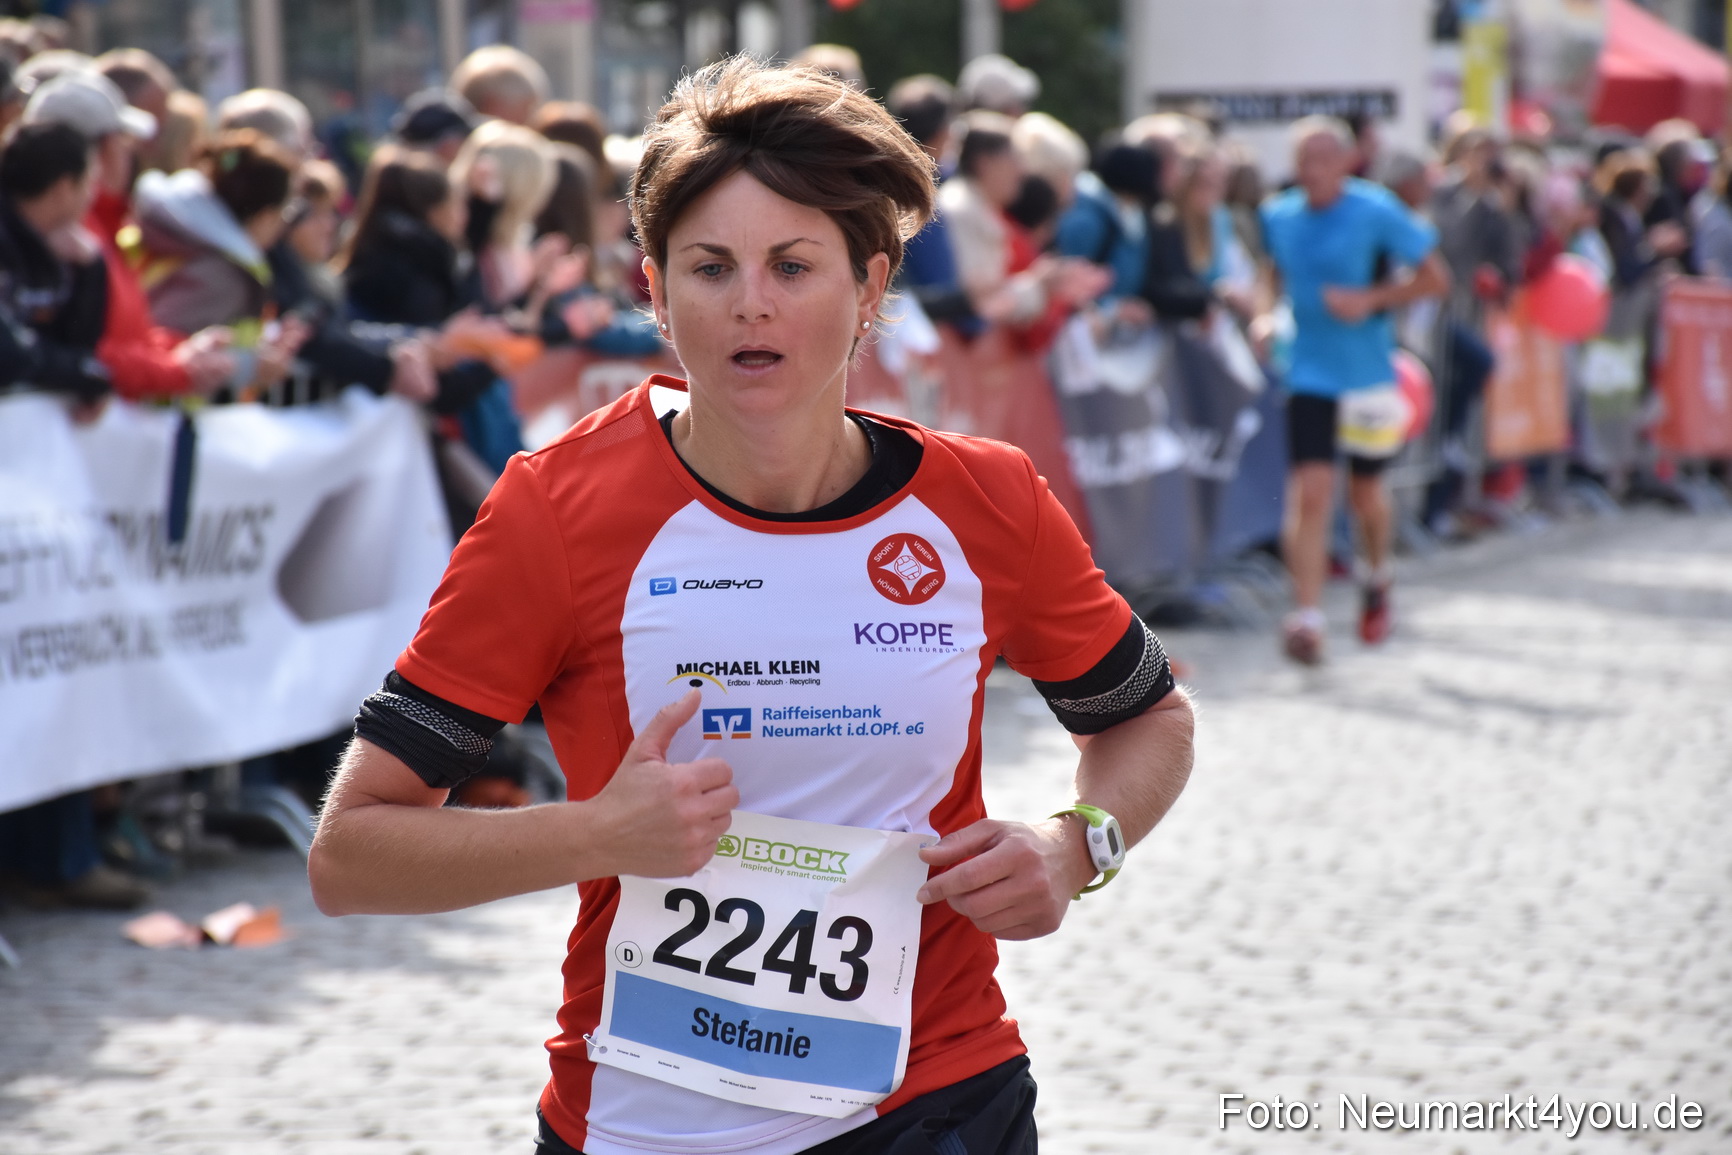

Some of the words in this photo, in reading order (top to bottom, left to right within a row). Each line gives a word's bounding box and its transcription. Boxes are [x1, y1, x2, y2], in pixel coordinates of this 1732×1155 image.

[873, 541, 895, 562] SPORT-
[913, 540, 934, 562] VEREIN
[921, 578, 939, 595] BERG
[853, 622, 954, 646] KOPPE
[676, 661, 763, 676] MICHAEL
[768, 660, 821, 675] KLEIN
[727, 679, 751, 687] Erdbau
[756, 678, 783, 686] Abbruch
[789, 678, 821, 687] Recycling
[761, 704, 882, 721] Raiffeisenbank
[761, 722, 843, 738] Neumarkt
[846, 722, 901, 737] i.d.OPf.
[905, 722, 925, 735] eG
[741, 836, 850, 875] BOCK
[740, 860, 773, 873] inspired
[774, 866, 785, 876] by
[786, 868, 810, 879] smart
[812, 873, 847, 884] concepts
[623, 947, 634, 962] D
[652, 888, 874, 1002] 2243
[691, 1007, 811, 1059] Stefanie
